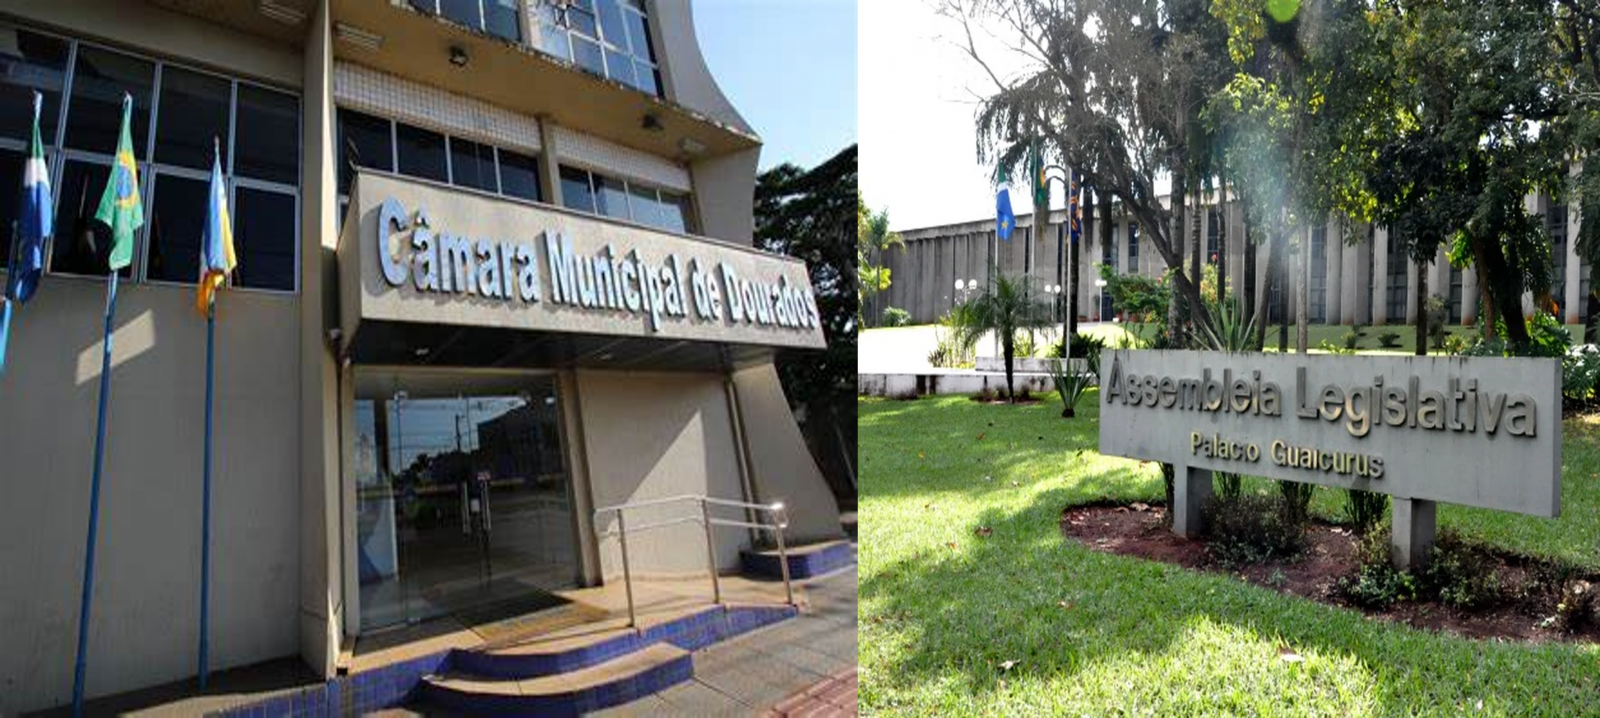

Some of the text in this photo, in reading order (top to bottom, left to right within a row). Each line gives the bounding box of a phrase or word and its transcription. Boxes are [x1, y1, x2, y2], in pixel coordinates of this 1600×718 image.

[377, 196, 818, 332] Câmara Municipal de Dourados
[1106, 357, 1537, 437] Assembleia Legislativa
[1271, 439, 1384, 479] Guaicurus
